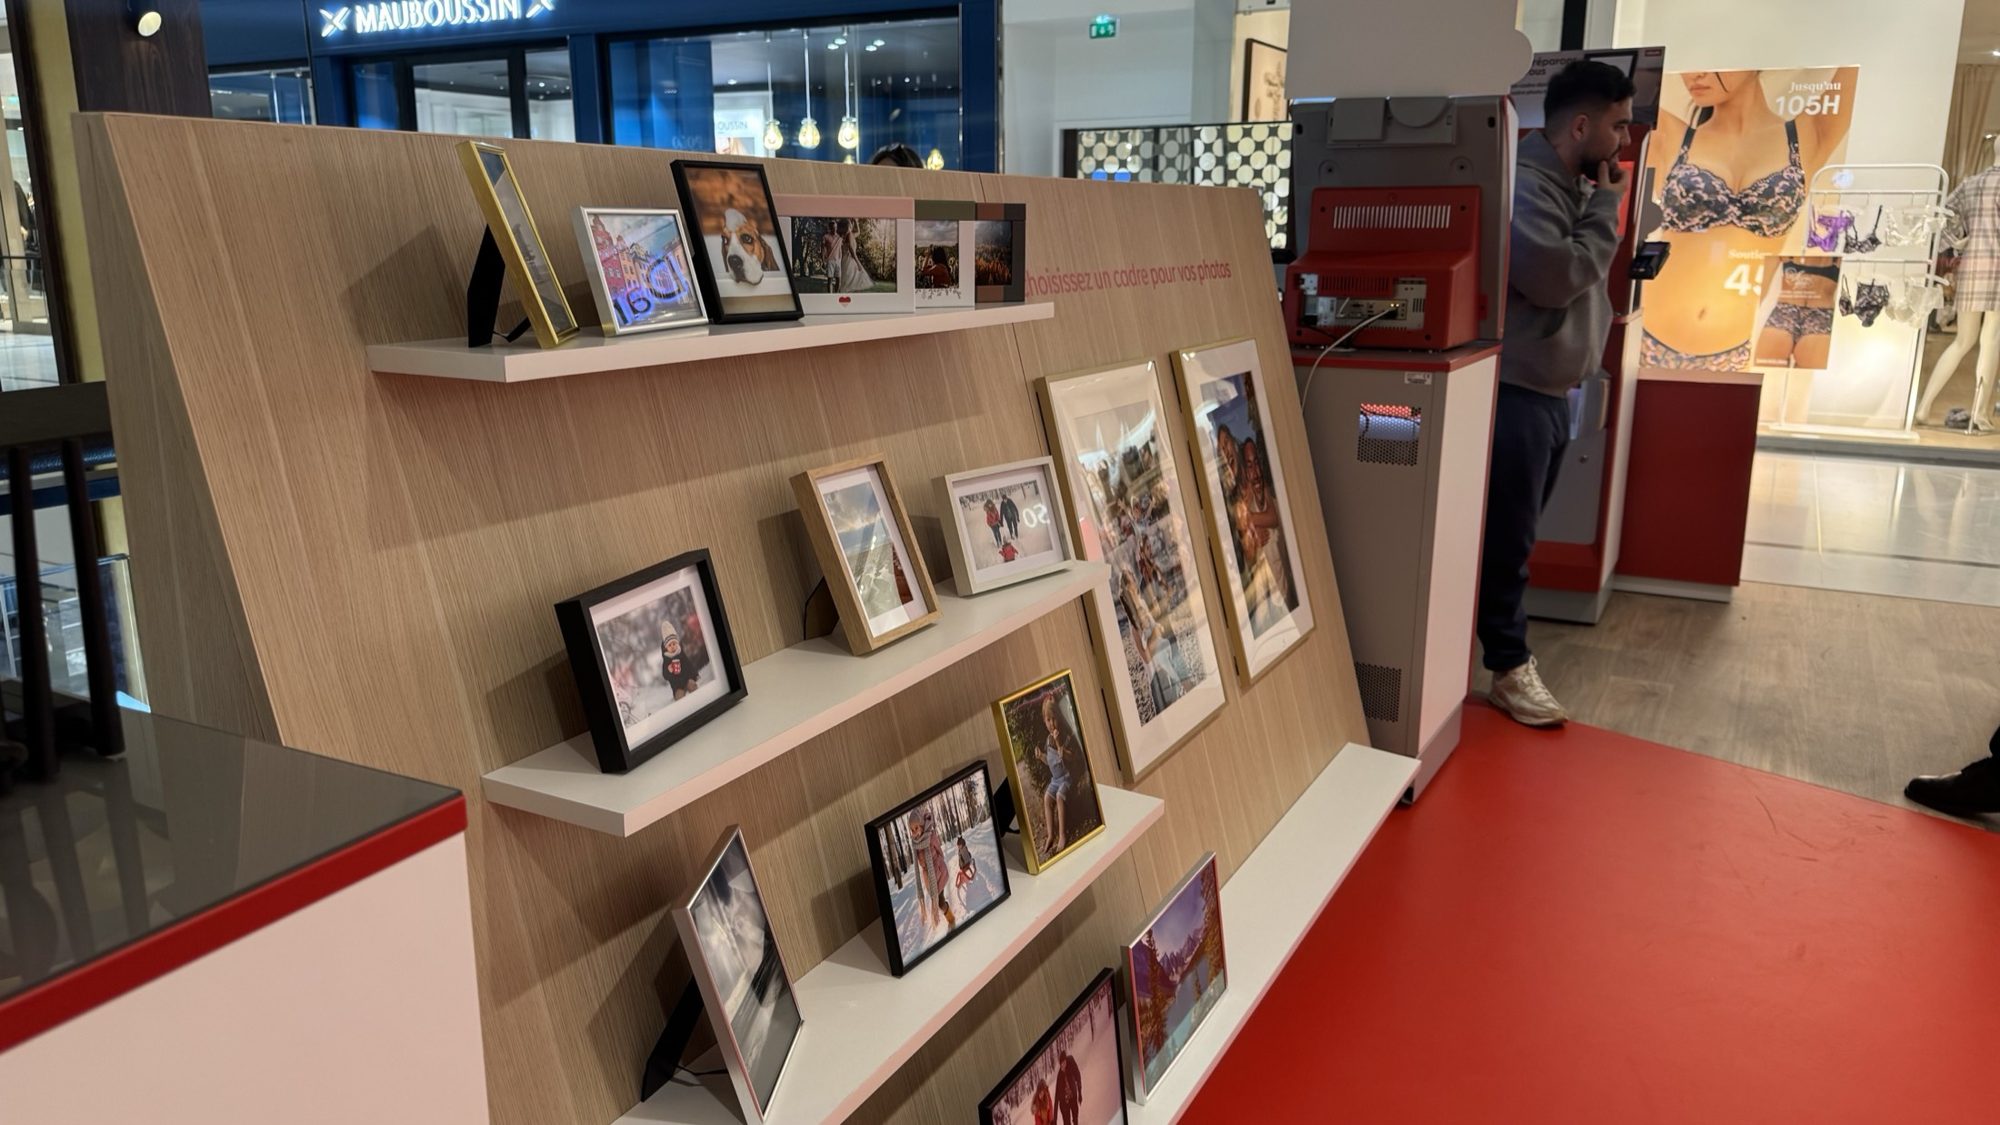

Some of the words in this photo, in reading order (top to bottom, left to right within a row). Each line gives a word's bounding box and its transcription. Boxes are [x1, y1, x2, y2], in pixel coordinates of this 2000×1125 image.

[355, 0, 521, 33] MAUBOUSSIN
[1775, 94, 1841, 116] 105H
[717, 121, 748, 131] OUSSIN
[1094, 270, 1112, 290] un
[1113, 263, 1149, 287] cadre
[1150, 265, 1177, 289] pour
[1177, 264, 1197, 282] vos
[1197, 259, 1232, 286] photos
